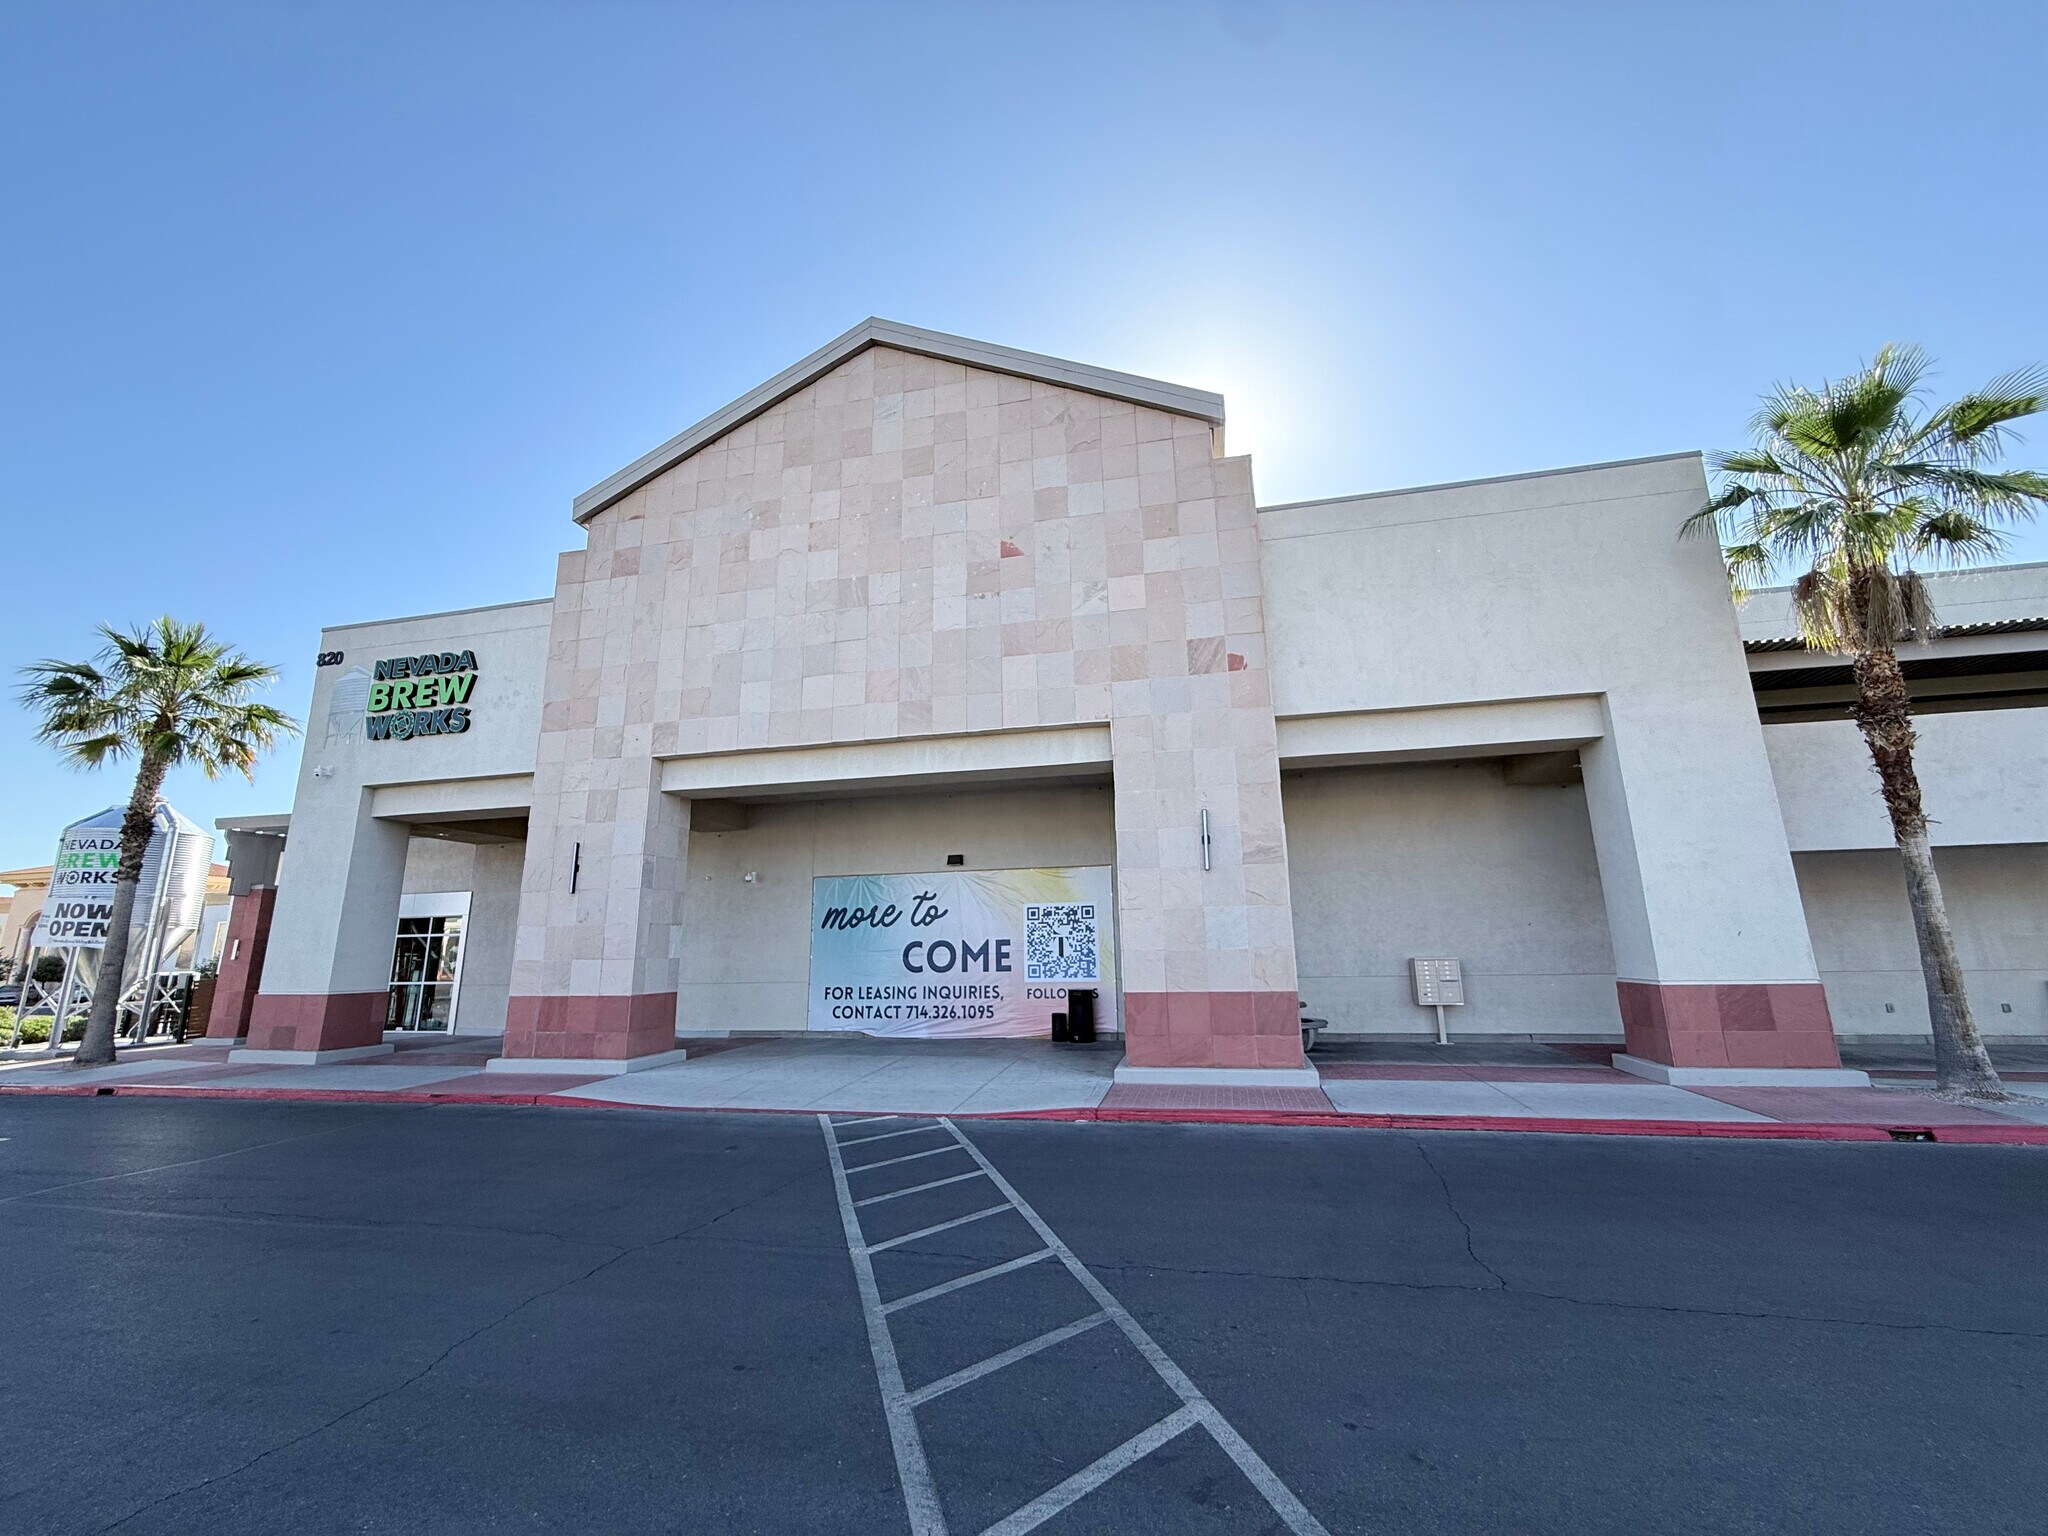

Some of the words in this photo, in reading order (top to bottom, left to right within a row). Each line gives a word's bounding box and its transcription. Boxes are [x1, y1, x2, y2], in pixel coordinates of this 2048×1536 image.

[317, 651, 344, 667] 820
[373, 650, 478, 680] NEVADA
[367, 674, 478, 712] BREW
[366, 707, 471, 741] WORKS
[55, 903, 113, 919] NOW
[821, 903, 903, 930] more
[910, 890, 949, 927] to
[50, 921, 110, 937] OPEN
[902, 938, 1012, 974] COME
[824, 986, 853, 1000] FOR
[859, 985, 917, 1000] LEASING
[922, 985, 1004, 1002] INQUIRIES,
[1027, 988, 1069, 999] FOLLO
[832, 1005, 901, 1019] CONTACT
[906, 1004, 994, 1019] 714.326.1095
